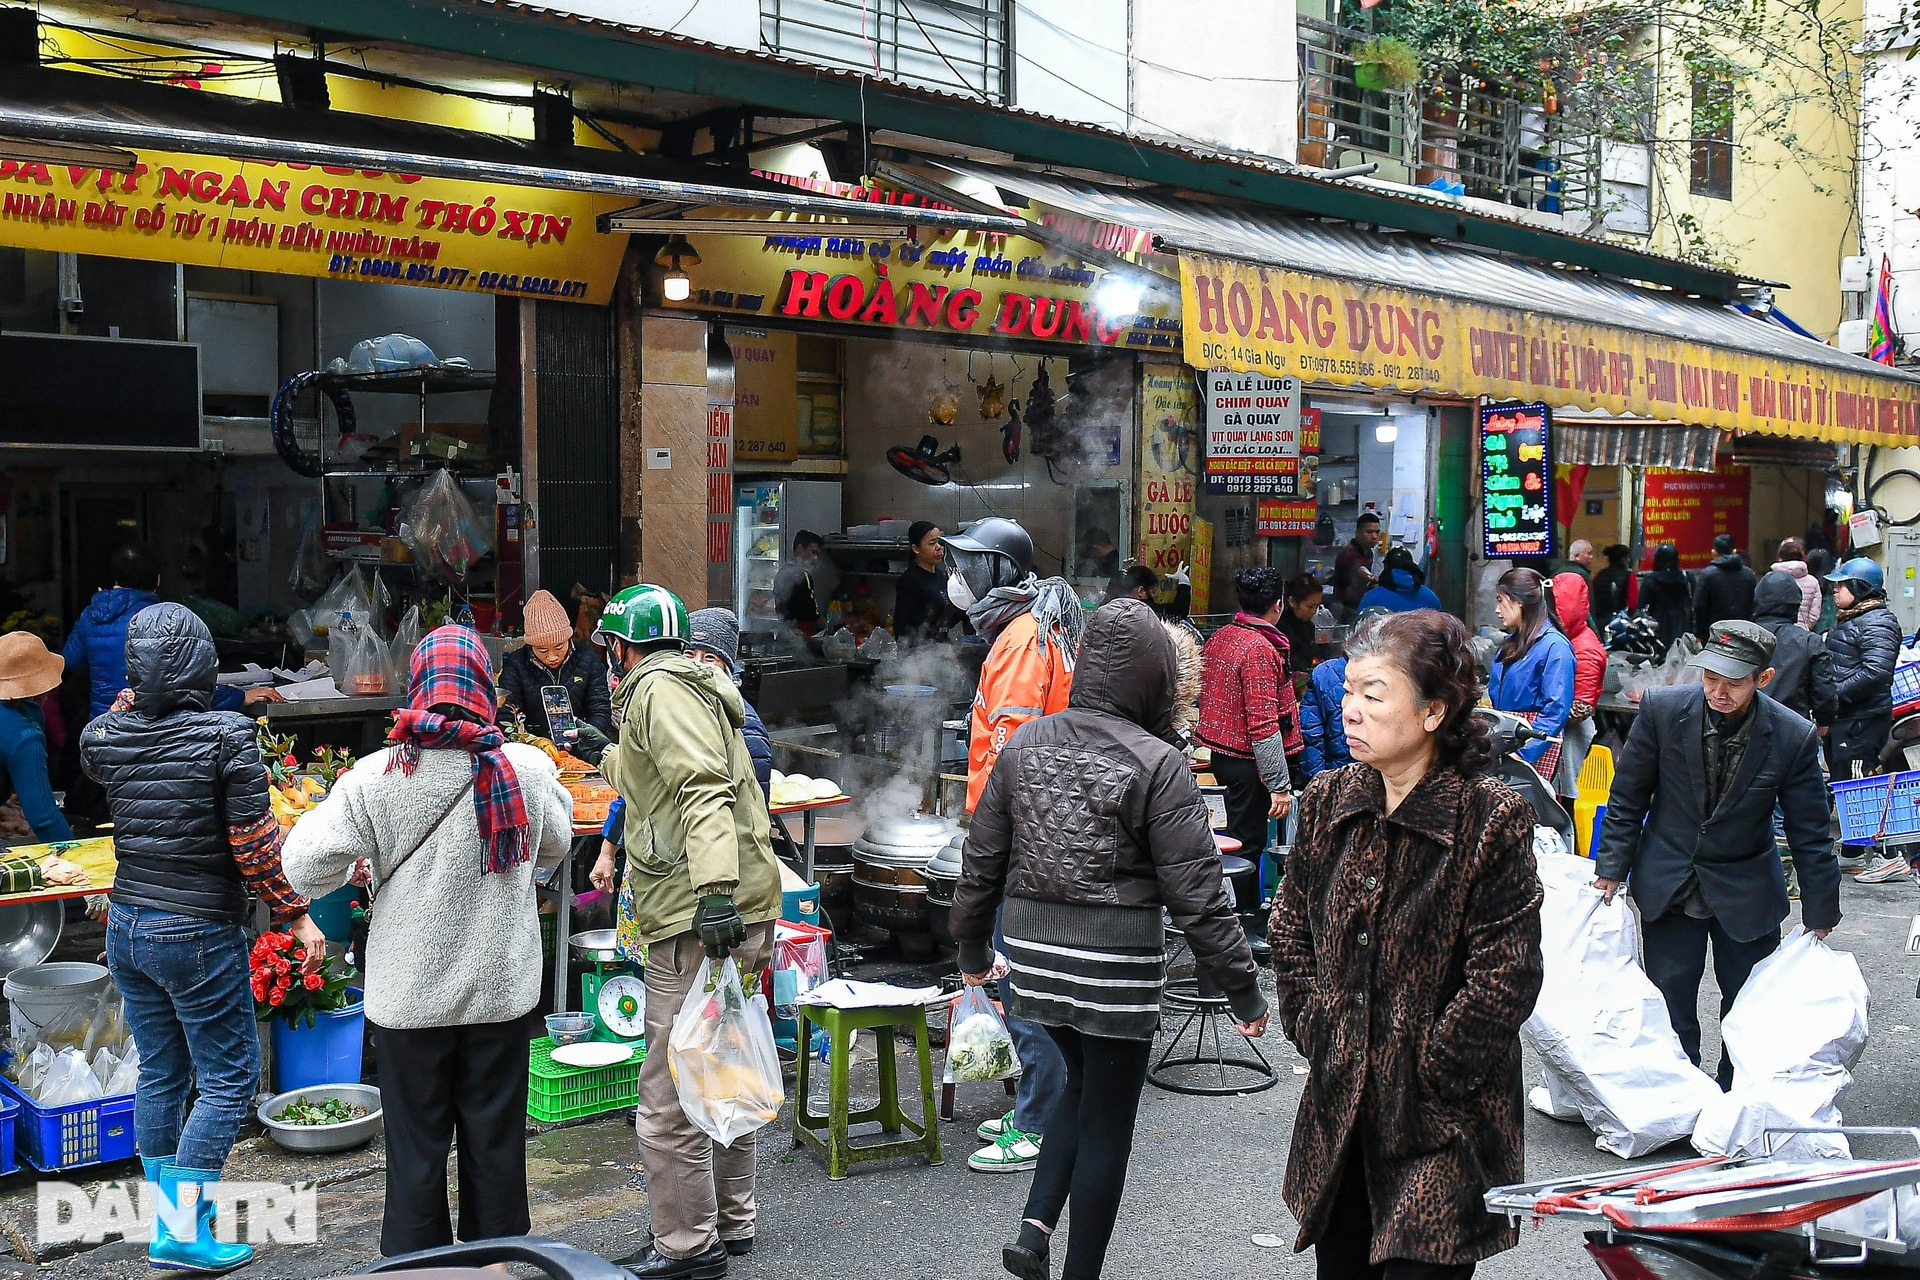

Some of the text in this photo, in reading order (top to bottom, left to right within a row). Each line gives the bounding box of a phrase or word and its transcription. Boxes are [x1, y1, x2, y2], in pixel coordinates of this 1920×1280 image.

[159, 166, 290, 210] NGAN
[301, 185, 409, 223] CHIM
[420, 195, 496, 234] THỎ
[499, 210, 572, 248] XỊN
[175, 209, 206, 236] TỪ
[209, 217, 220, 238] 1
[225, 216, 276, 248] MÓN
[280, 221, 323, 250] ĐẾN
[326, 228, 386, 255] NHIỀU
[974, 252, 1012, 273] món
[782, 261, 1125, 344] HOÀNG DUNG
[1195, 268, 1445, 360] HOÀNG DUNG
[1230, 346, 1243, 361] 14
[1245, 348, 1262, 365] Gia
[1214, 378, 1233, 392] GÀ
[1237, 376, 1253, 391] LỄ
[1215, 396, 1290, 409] CHIM QUAY
[707, 405, 731, 438] IỂM
[1224, 412, 1281, 426] GÀ QUAY
[748, 441, 765, 452] 287
[768, 441, 786, 453] 640
[1211, 430, 1294, 444] VỊT QUAY LẠNG SƠN
[1212, 443, 1293, 456] XÔI CÁC LOẠI...
[1147, 475, 1170, 503] GÀ
[1227, 475, 1252, 484] 0978
[1253, 475, 1278, 484] 5555
[1280, 475, 1293, 484] 66
[1227, 484, 1293, 493] 0912 287 640
[707, 472, 731, 515] HIM
[1148, 507, 1190, 540] LUỘC
[1269, 521, 1287, 530] 0912
[1288, 521, 1300, 530] 287
[707, 521, 731, 563] UAY
